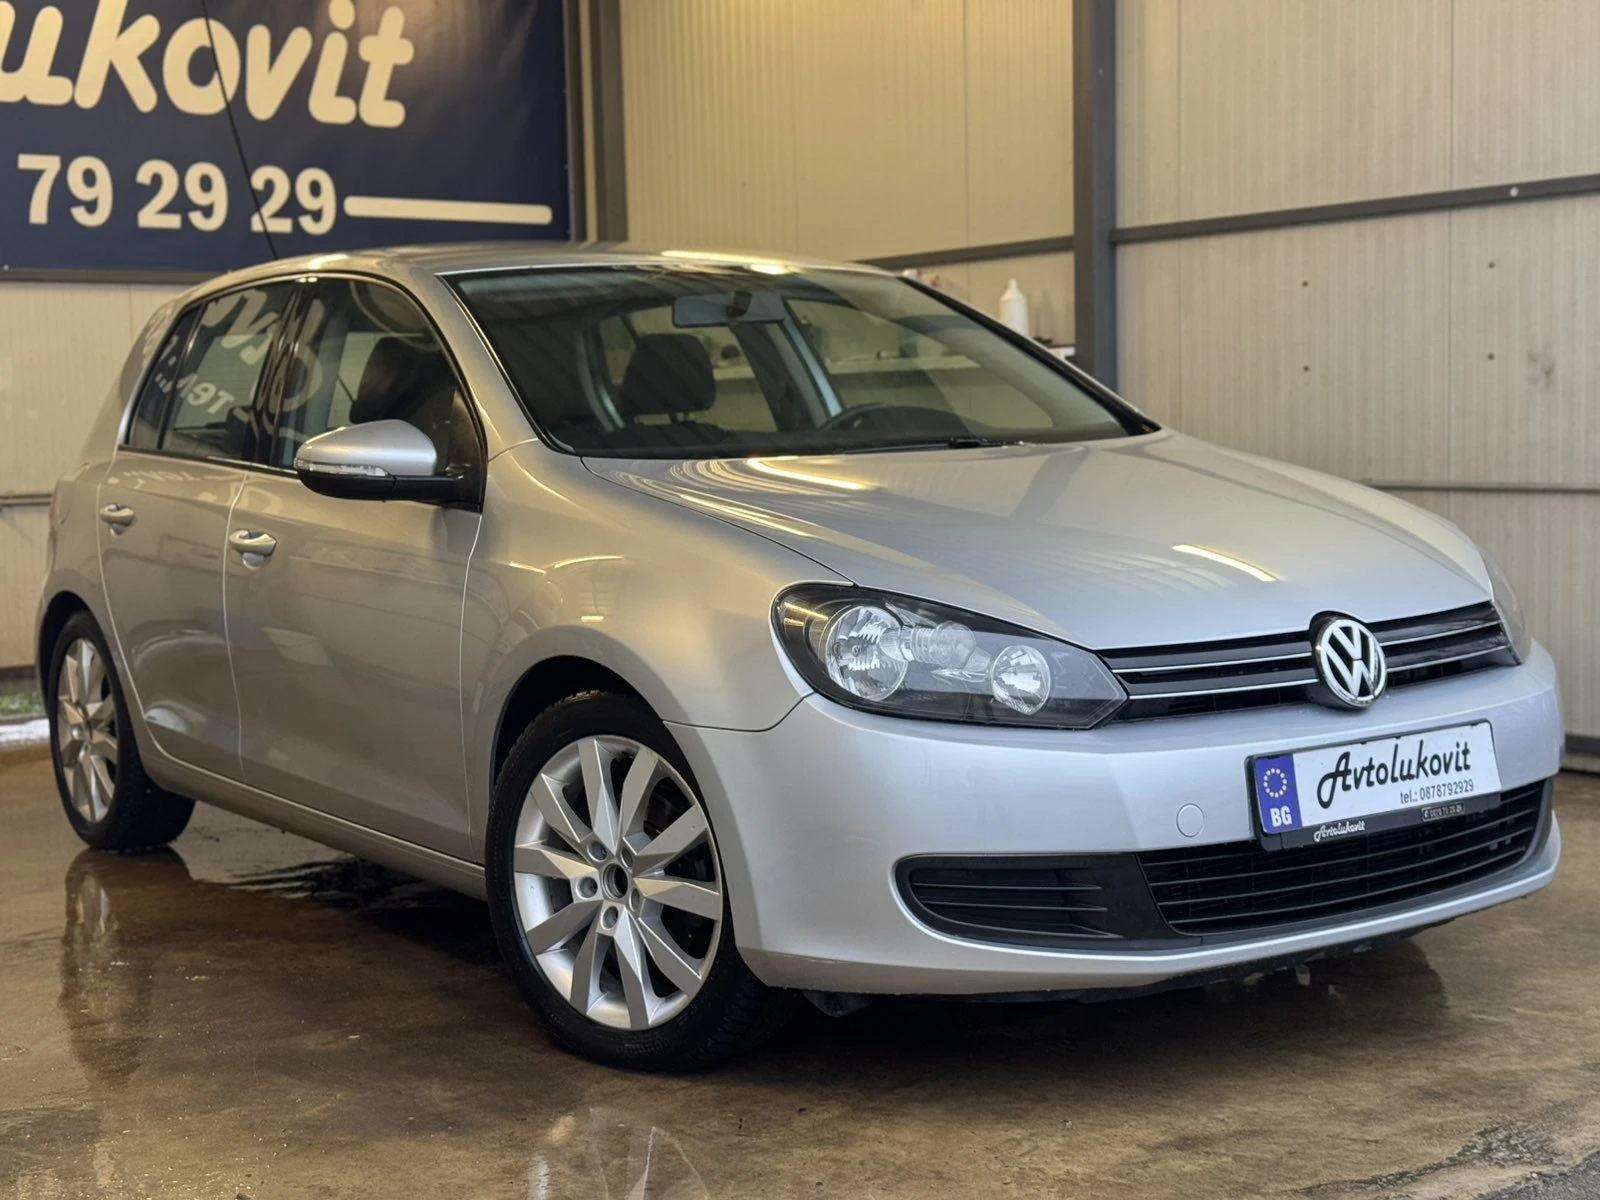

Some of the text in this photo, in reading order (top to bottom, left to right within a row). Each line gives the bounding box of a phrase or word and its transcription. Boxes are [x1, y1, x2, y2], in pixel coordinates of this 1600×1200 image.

[17, 154, 337, 236] 79 29 29
[1316, 739, 1471, 809] Avtolukovit
[1419, 779, 1474, 801] 0878792929
[1269, 807, 1292, 828] BG
